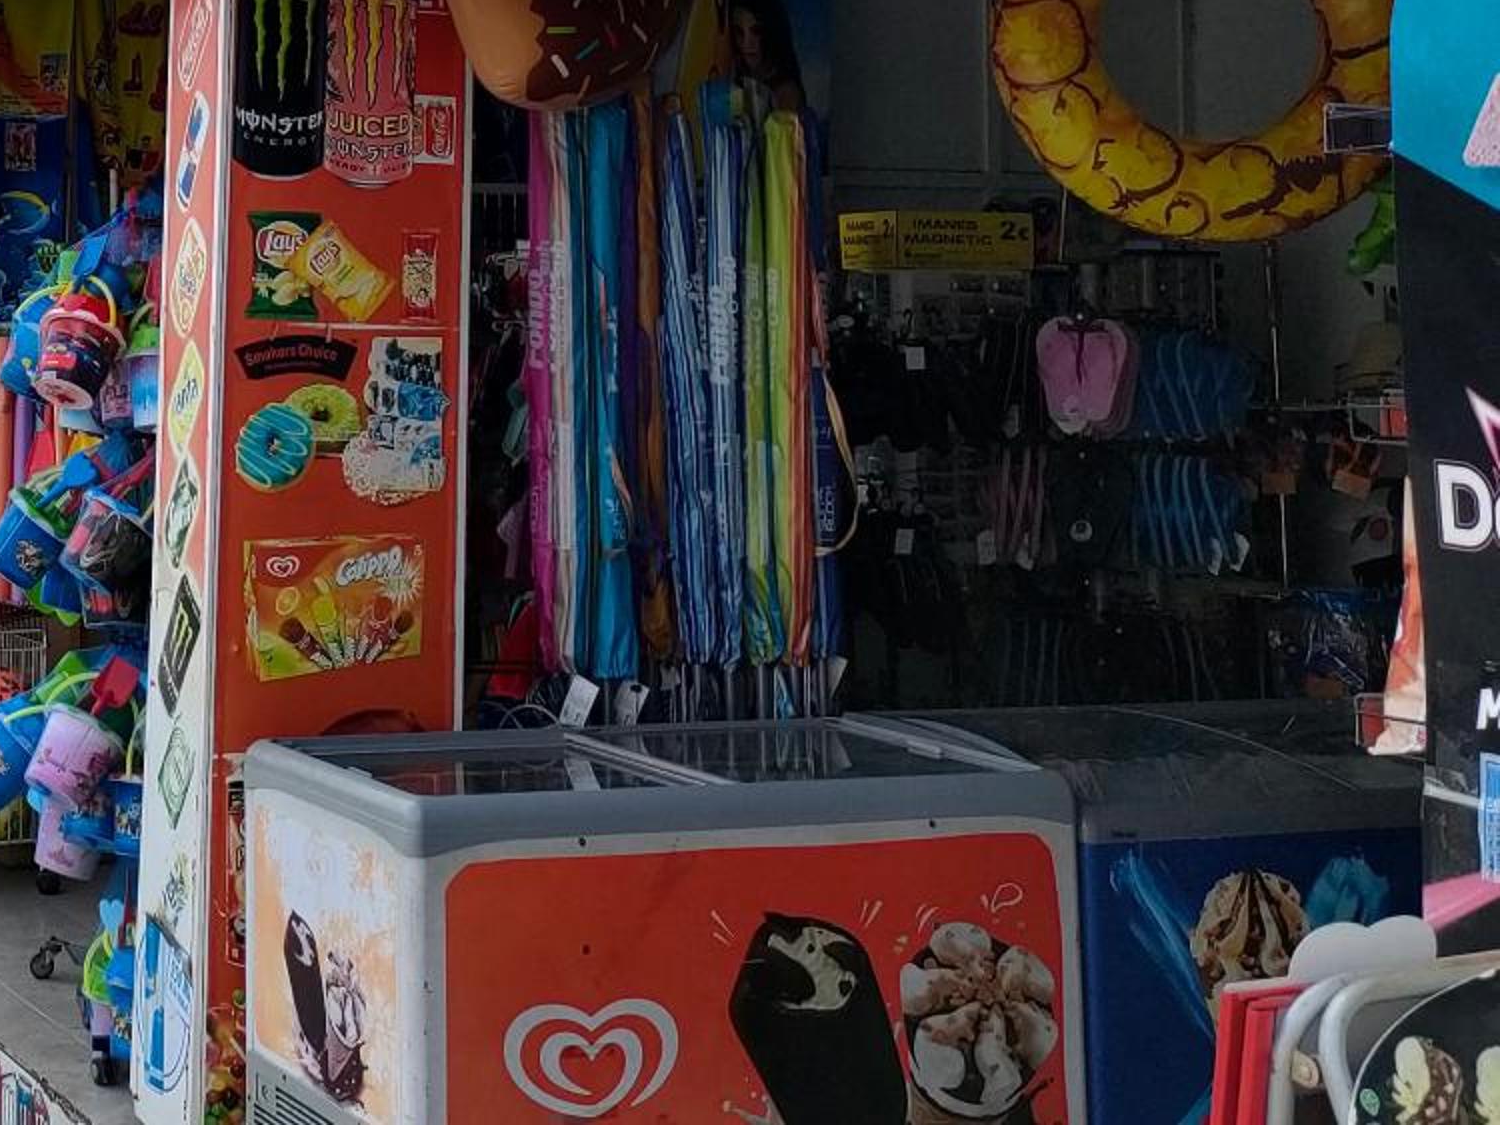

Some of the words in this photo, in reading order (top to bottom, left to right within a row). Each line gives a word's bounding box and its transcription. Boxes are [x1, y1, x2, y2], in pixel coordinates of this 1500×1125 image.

[328, 109, 411, 138] JUICED
[912, 219, 980, 232] IMANES
[902, 234, 994, 247] MAGNETIC
[1435, 459, 1500, 552] D
